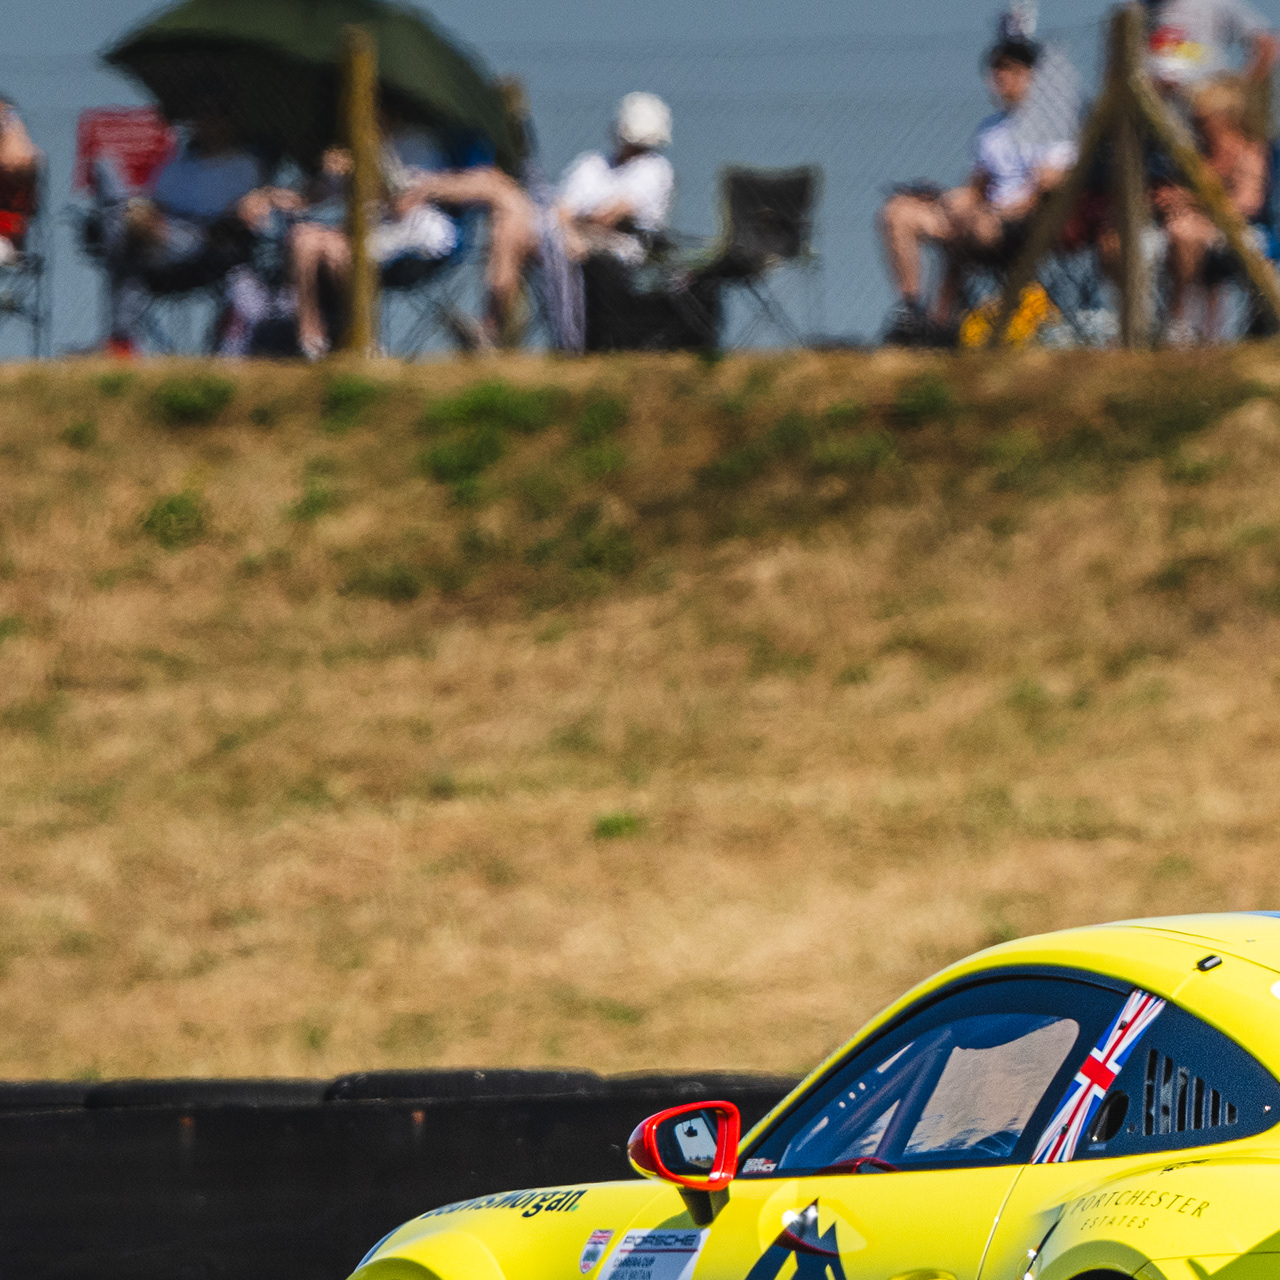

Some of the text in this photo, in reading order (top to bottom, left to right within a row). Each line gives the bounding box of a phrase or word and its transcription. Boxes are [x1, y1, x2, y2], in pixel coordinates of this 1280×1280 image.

[1070, 1190, 1210, 1218] PORTCHESTER
[1080, 1215, 1150, 1231] ESTATES
[623, 1234, 698, 1247] PORSCHE
